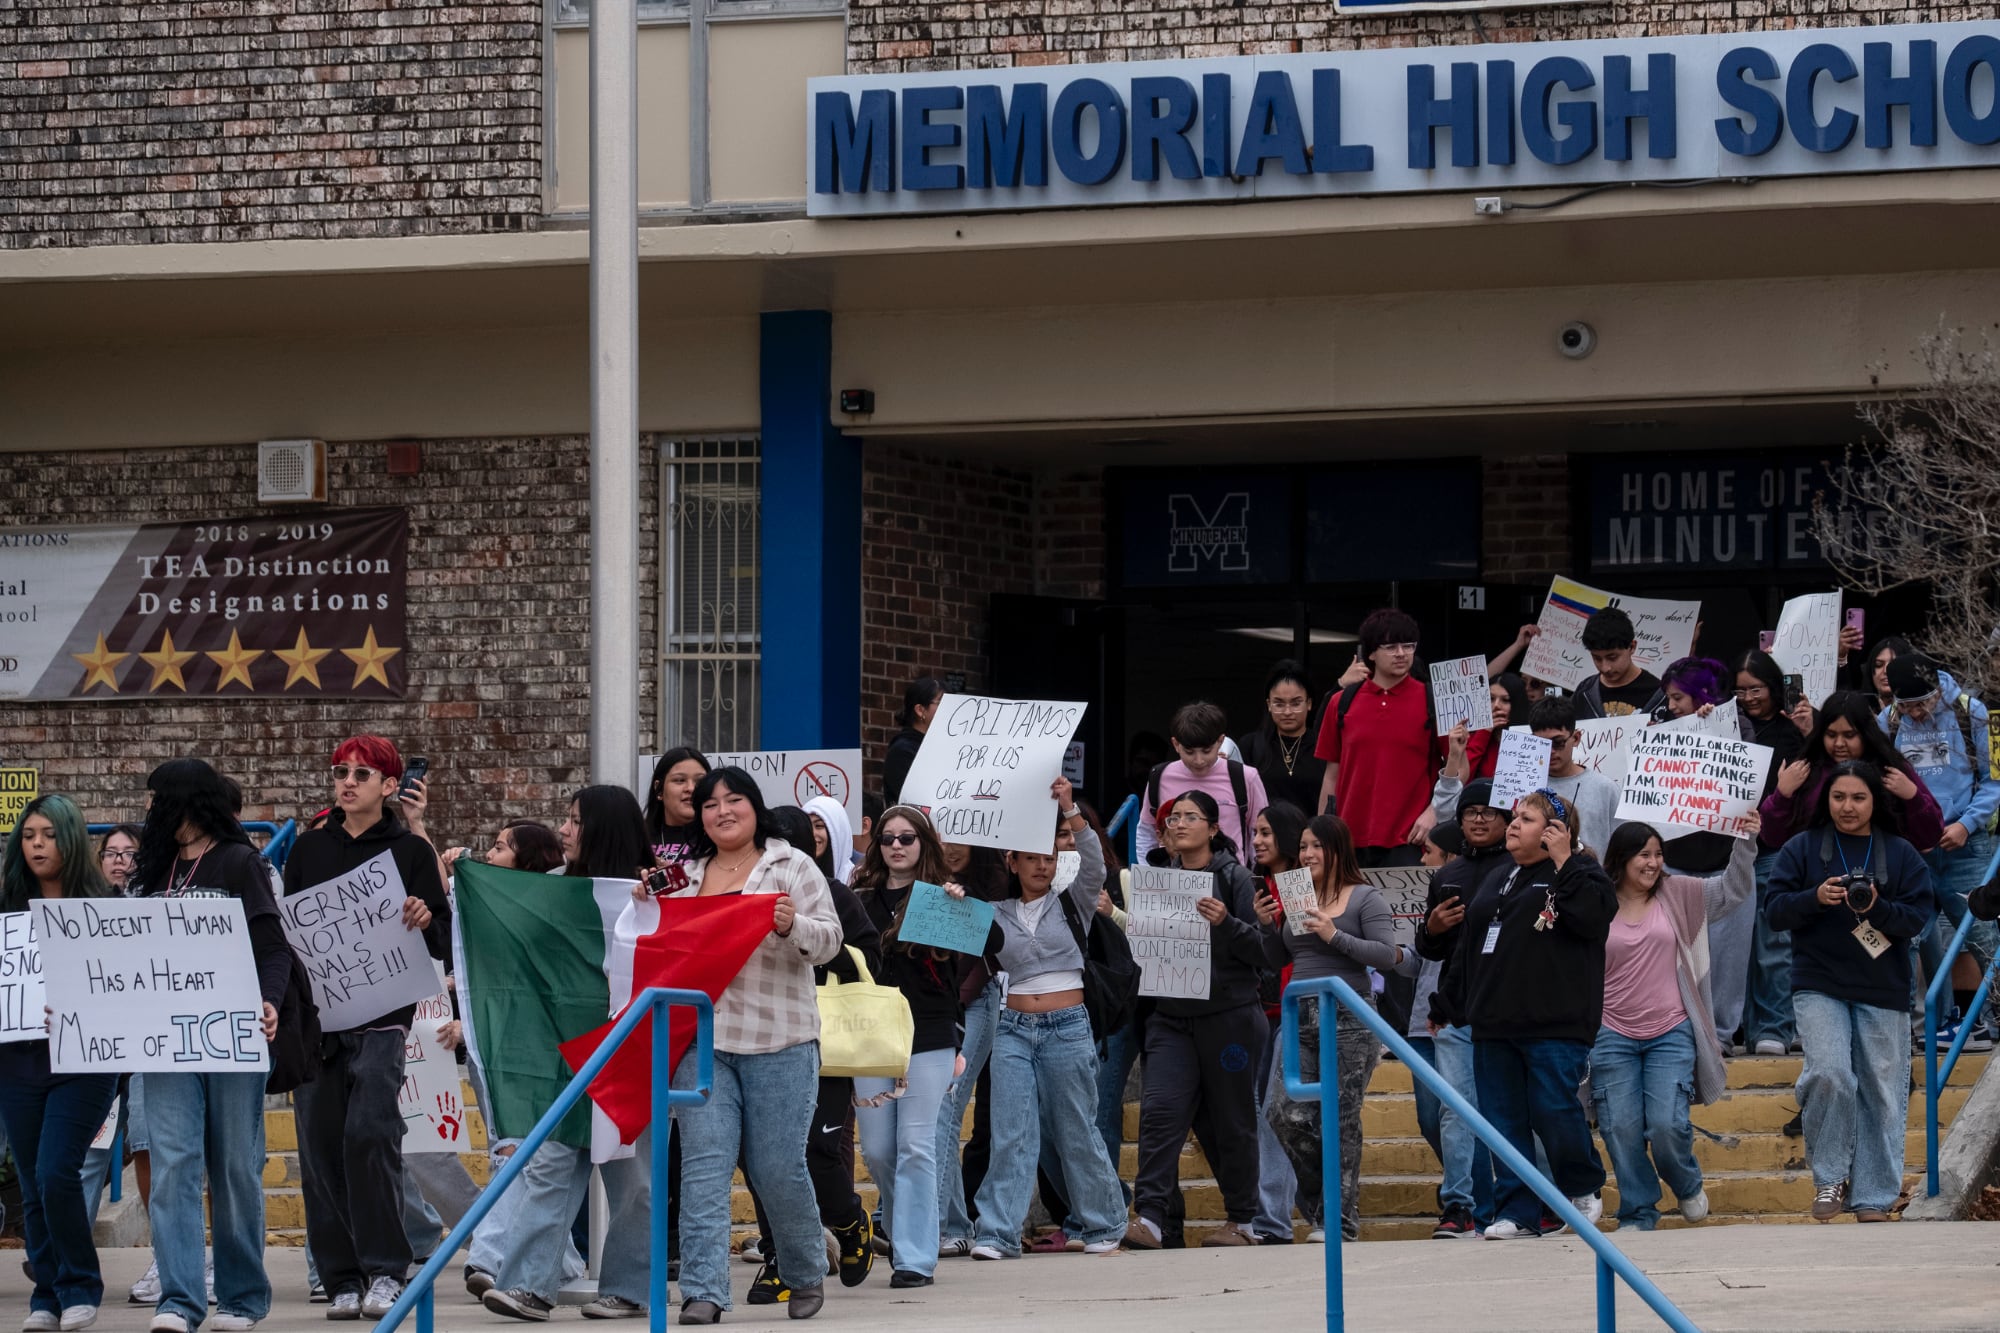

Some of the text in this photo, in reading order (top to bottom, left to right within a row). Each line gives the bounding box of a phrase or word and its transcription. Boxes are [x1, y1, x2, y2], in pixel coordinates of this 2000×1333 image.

[814, 68, 1375, 196] MEMORIAL
[1407, 52, 1677, 170] HIGH
[1622, 470, 1735, 512] HOME
[1760, 467, 1812, 508] OF
[194, 526, 249, 542] 2018
[277, 523, 334, 541] 2019
[1171, 527, 1247, 545] MINUTEMEN
[137, 554, 390, 579] TEA Distinction
[138, 588, 389, 620] Designations
[1808, 595, 1837, 620] THE
[1432, 657, 1485, 681] OUR VOICES
[1801, 653, 1818, 668] OF
[1434, 683, 1448, 697] CAN
[1450, 680, 1466, 694] ONLY
[947, 698, 1076, 738] GRITAMOS
[1503, 733, 1517, 743] YOU
[1651, 732, 1671, 745] AM
[1676, 735, 1694, 747] NO
[1696, 738, 1748, 755] LONGER
[956, 744, 1023, 771] POR LOS
[1633, 744, 1753, 768] ACCEPTING THE THINGS
[0, 773, 33, 790] ION
[1634, 756, 1758, 784] I CANNOT CHANGE
[936, 779, 1002, 799] QUE NO
[1627, 774, 1631, 787] I
[1635, 774, 1654, 787] AM
[1658, 776, 1723, 794] CHANGING
[1726, 783, 1758, 801] THE
[1624, 789, 1728, 814] THINGS I CANNOT
[936, 806, 1003, 839] PUEDEN!
[1134, 867, 1212, 890] DON'T FORGET
[1283, 869, 1305, 885] FIGHT
[1133, 893, 1192, 912] THE HANDS
[43, 904, 80, 939] NO
[83, 902, 152, 938] DECENT
[165, 902, 233, 936] HUMAN
[351, 899, 398, 935] the
[1178, 921, 1209, 940] CITY
[1174, 940, 1211, 959] FORGET
[86, 959, 125, 993] HAS
[151, 958, 215, 992] HEART
[58, 1011, 260, 1064] MADE OF ICE
